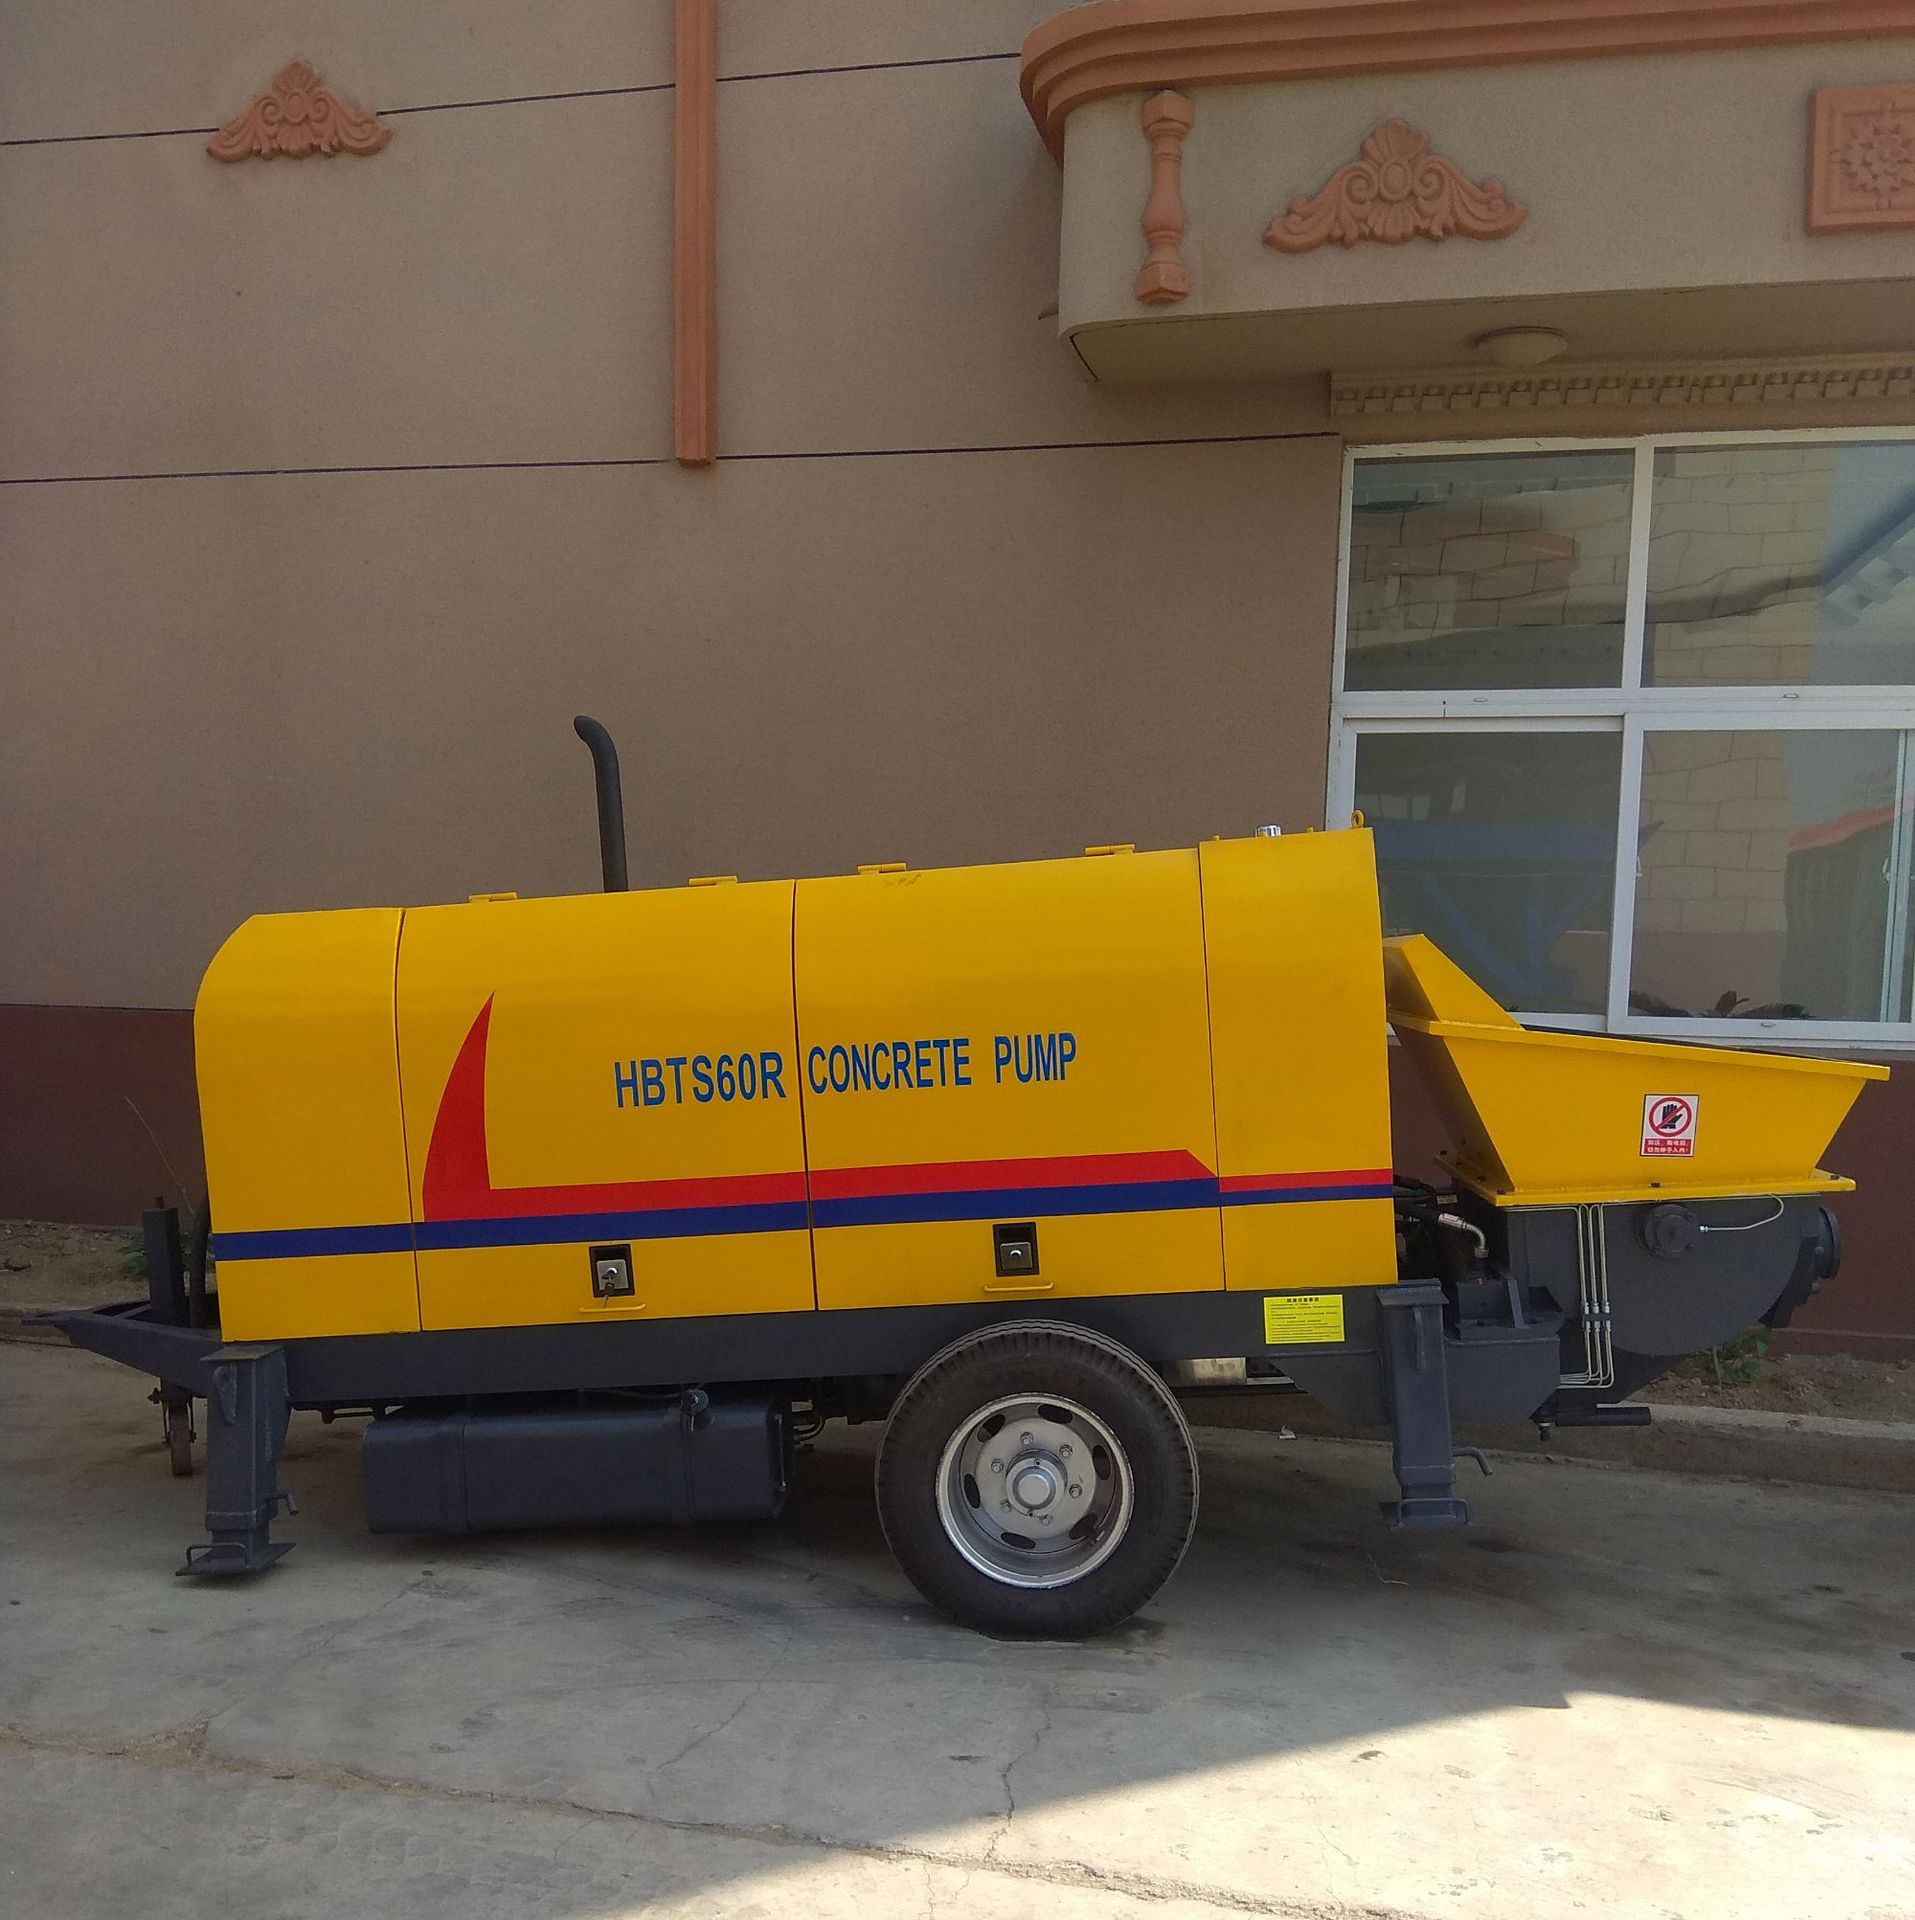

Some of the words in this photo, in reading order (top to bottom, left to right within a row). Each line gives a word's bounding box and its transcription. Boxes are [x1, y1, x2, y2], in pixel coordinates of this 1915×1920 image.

[614, 1052, 787, 1108] HBTS60R
[808, 1038, 972, 1094] CONCRETE
[994, 1032, 1076, 1084] PUMP
